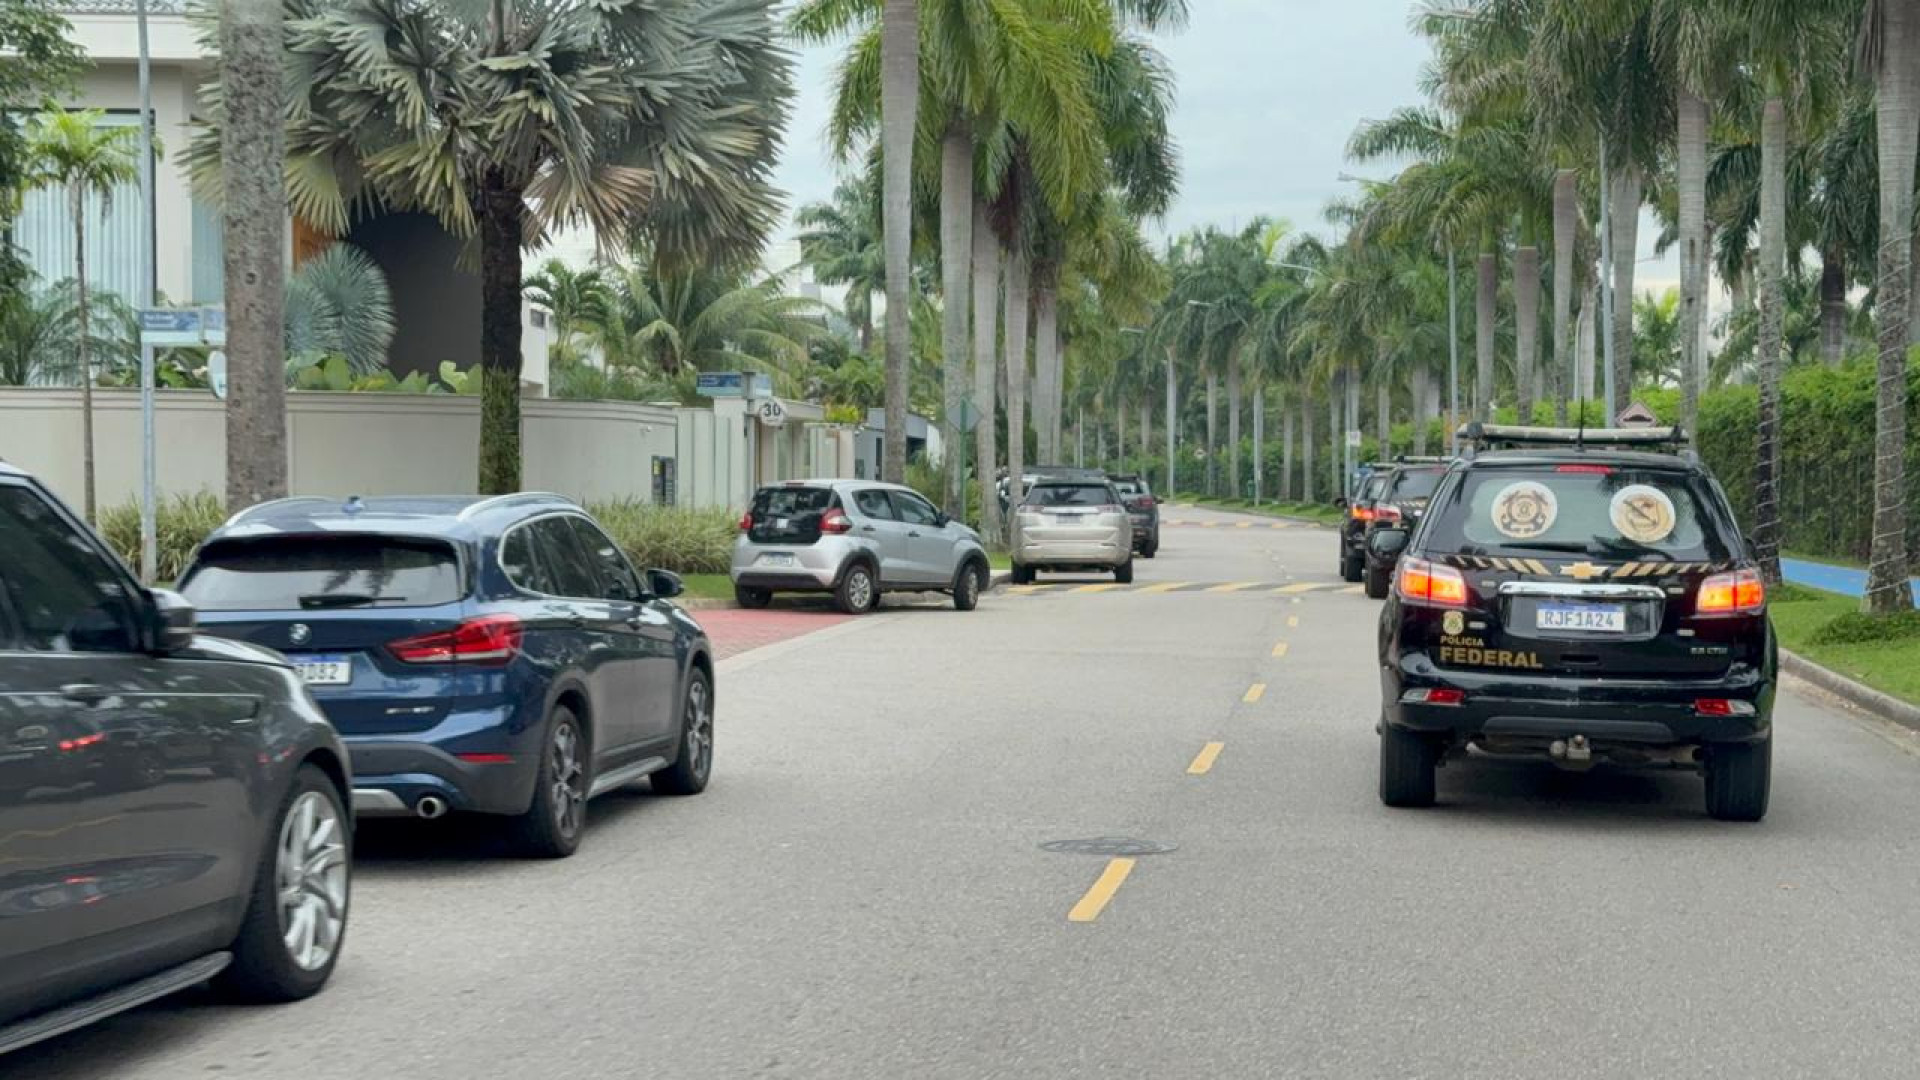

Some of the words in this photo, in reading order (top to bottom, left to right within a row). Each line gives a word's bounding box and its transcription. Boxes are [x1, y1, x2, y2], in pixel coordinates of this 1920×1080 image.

[764, 402, 781, 417] 30
[1544, 611, 1615, 628] RJF1A24
[1440, 647, 1544, 669] FEDERAL
